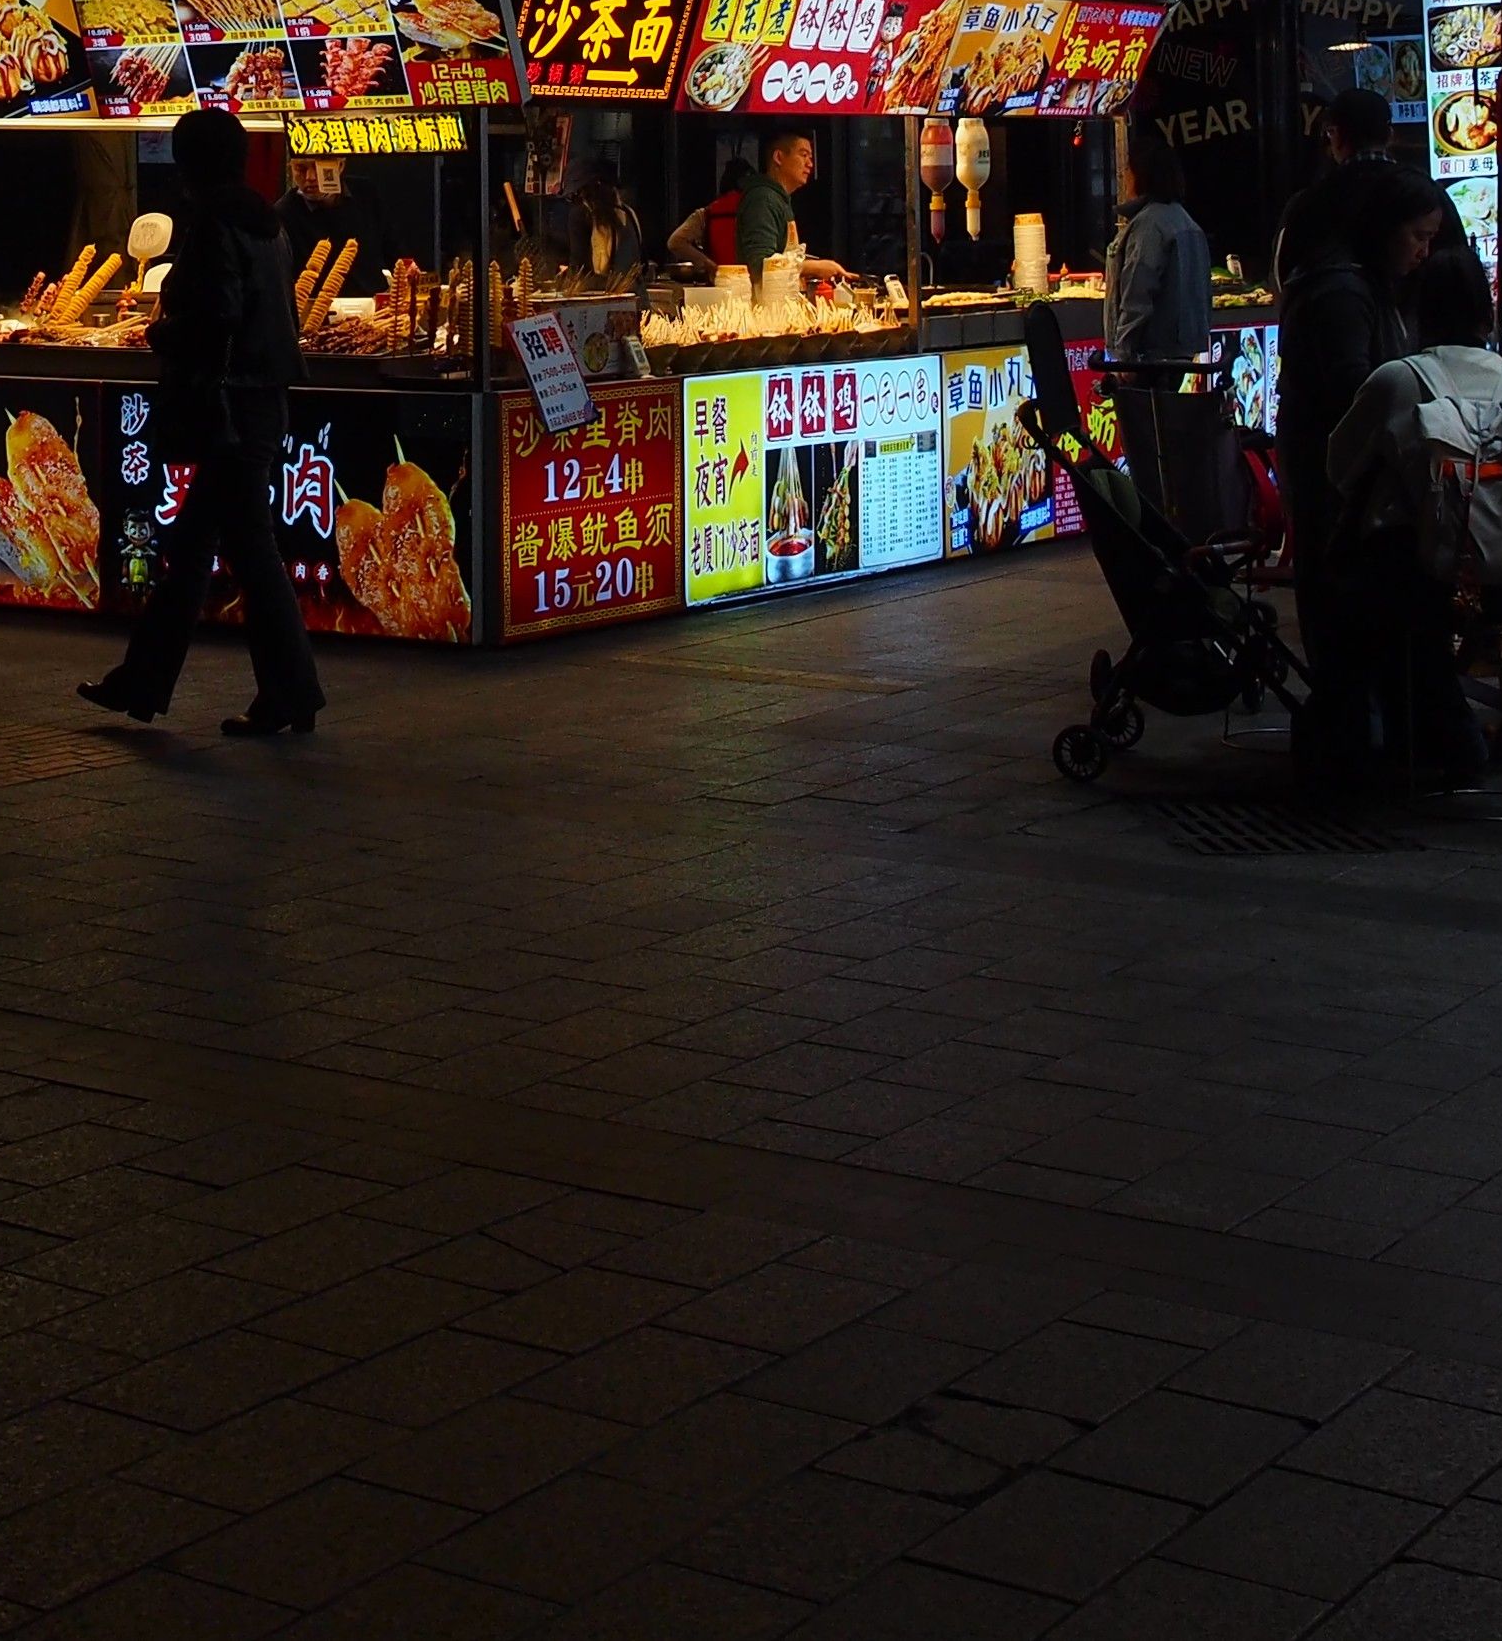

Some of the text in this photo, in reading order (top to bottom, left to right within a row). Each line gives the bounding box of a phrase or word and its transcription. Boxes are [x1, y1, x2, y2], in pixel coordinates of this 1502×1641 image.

[964, 4, 1056, 36] 章鱼小丸子
[431, 62, 487, 79] 12元4串
[526, 62, 585, 85] 砂锅粥
[1056, 34, 1147, 81] 海蛎煎
[1154, 44, 1238, 88] NEW
[419, 79, 509, 105] 沙茶里脊肉
[1156, 98, 1252, 149] YEAR
[522, 326, 564, 361] 招聘
[693, 397, 727, 447] 早餐
[768, 376, 857, 435] 钵钵鸡
[121, 393, 149, 484] 沙茶
[544, 453, 644, 503] 12元4串
[694, 453, 728, 509] 夜宵
[512, 502, 673, 569] 酱爆鱿鱼须
[690, 519, 760, 577] 老厦门沙茶面
[534, 557, 654, 614] 15元20串
